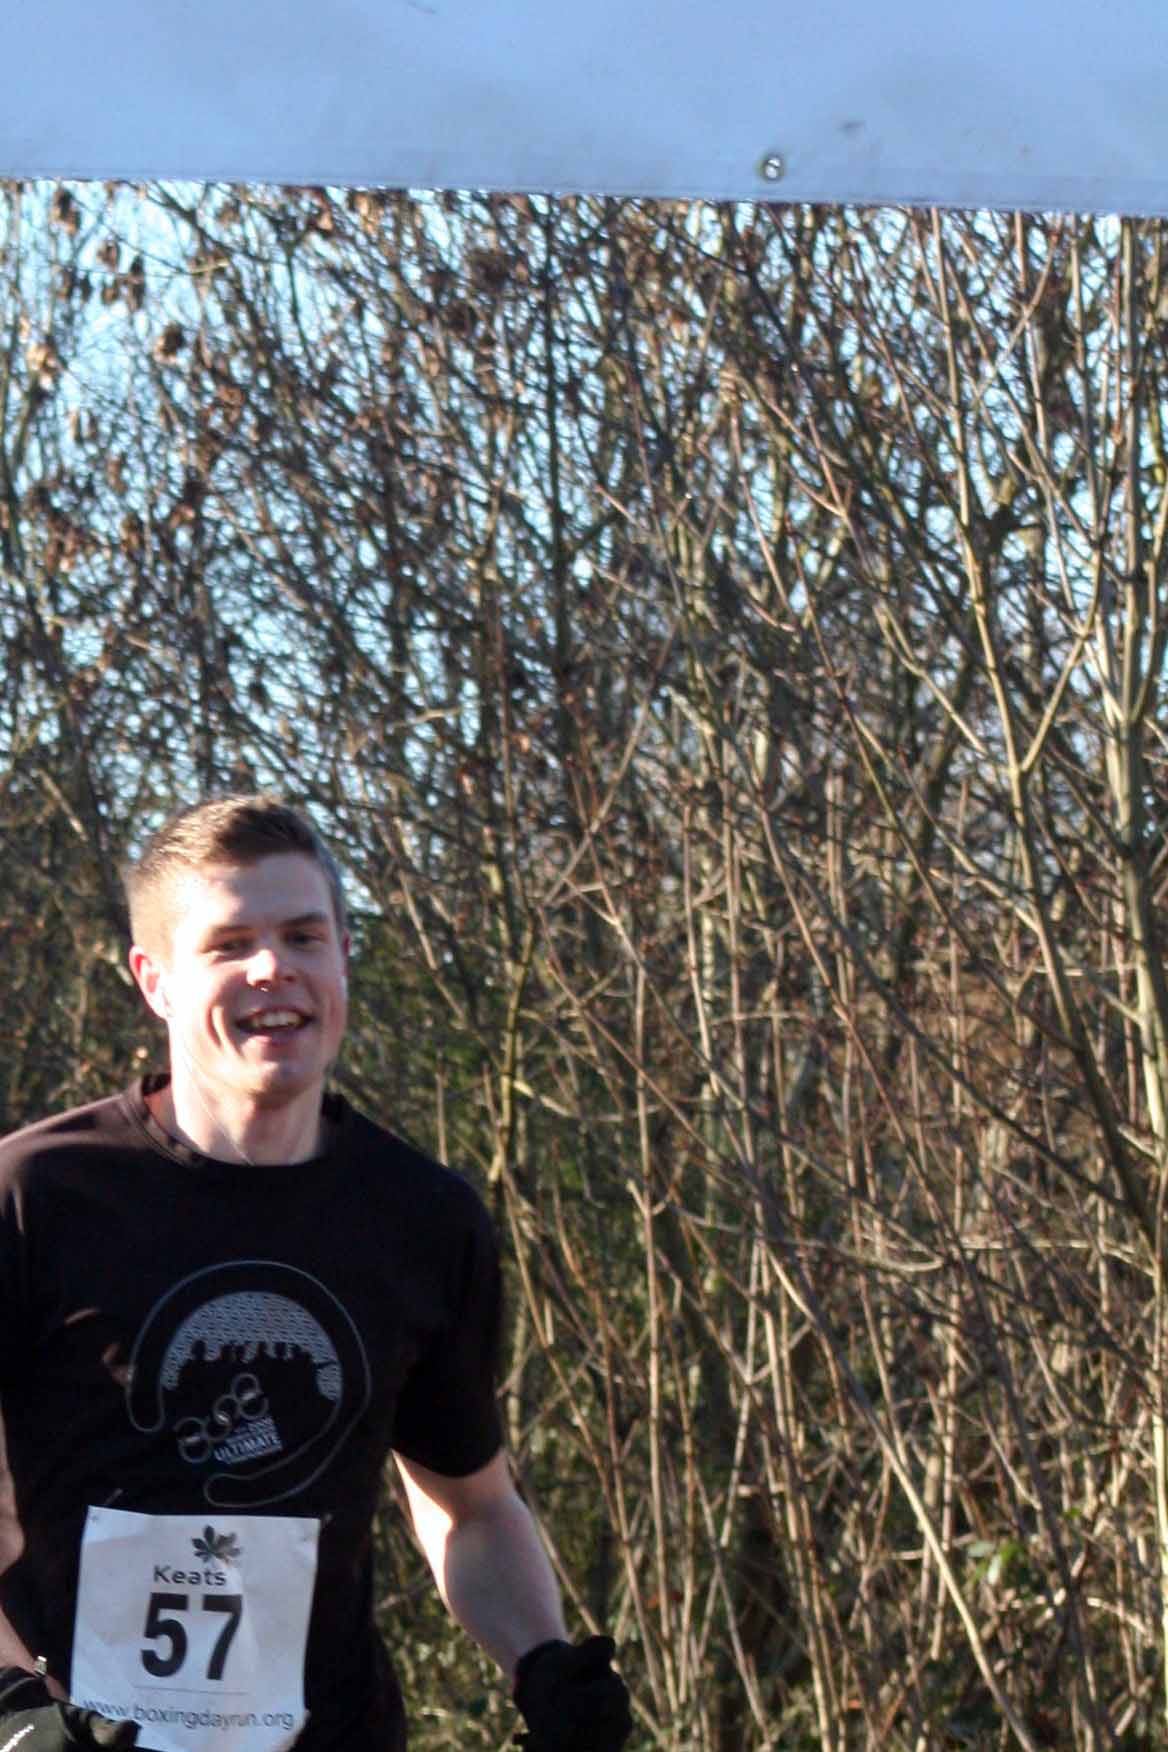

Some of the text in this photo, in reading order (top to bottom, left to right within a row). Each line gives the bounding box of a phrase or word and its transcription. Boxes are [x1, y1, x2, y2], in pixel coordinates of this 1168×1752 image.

[152, 1564, 227, 1586] Keats
[140, 1592, 243, 1681] 57
[83, 1700, 294, 1730] www.boxingdayrun.org
